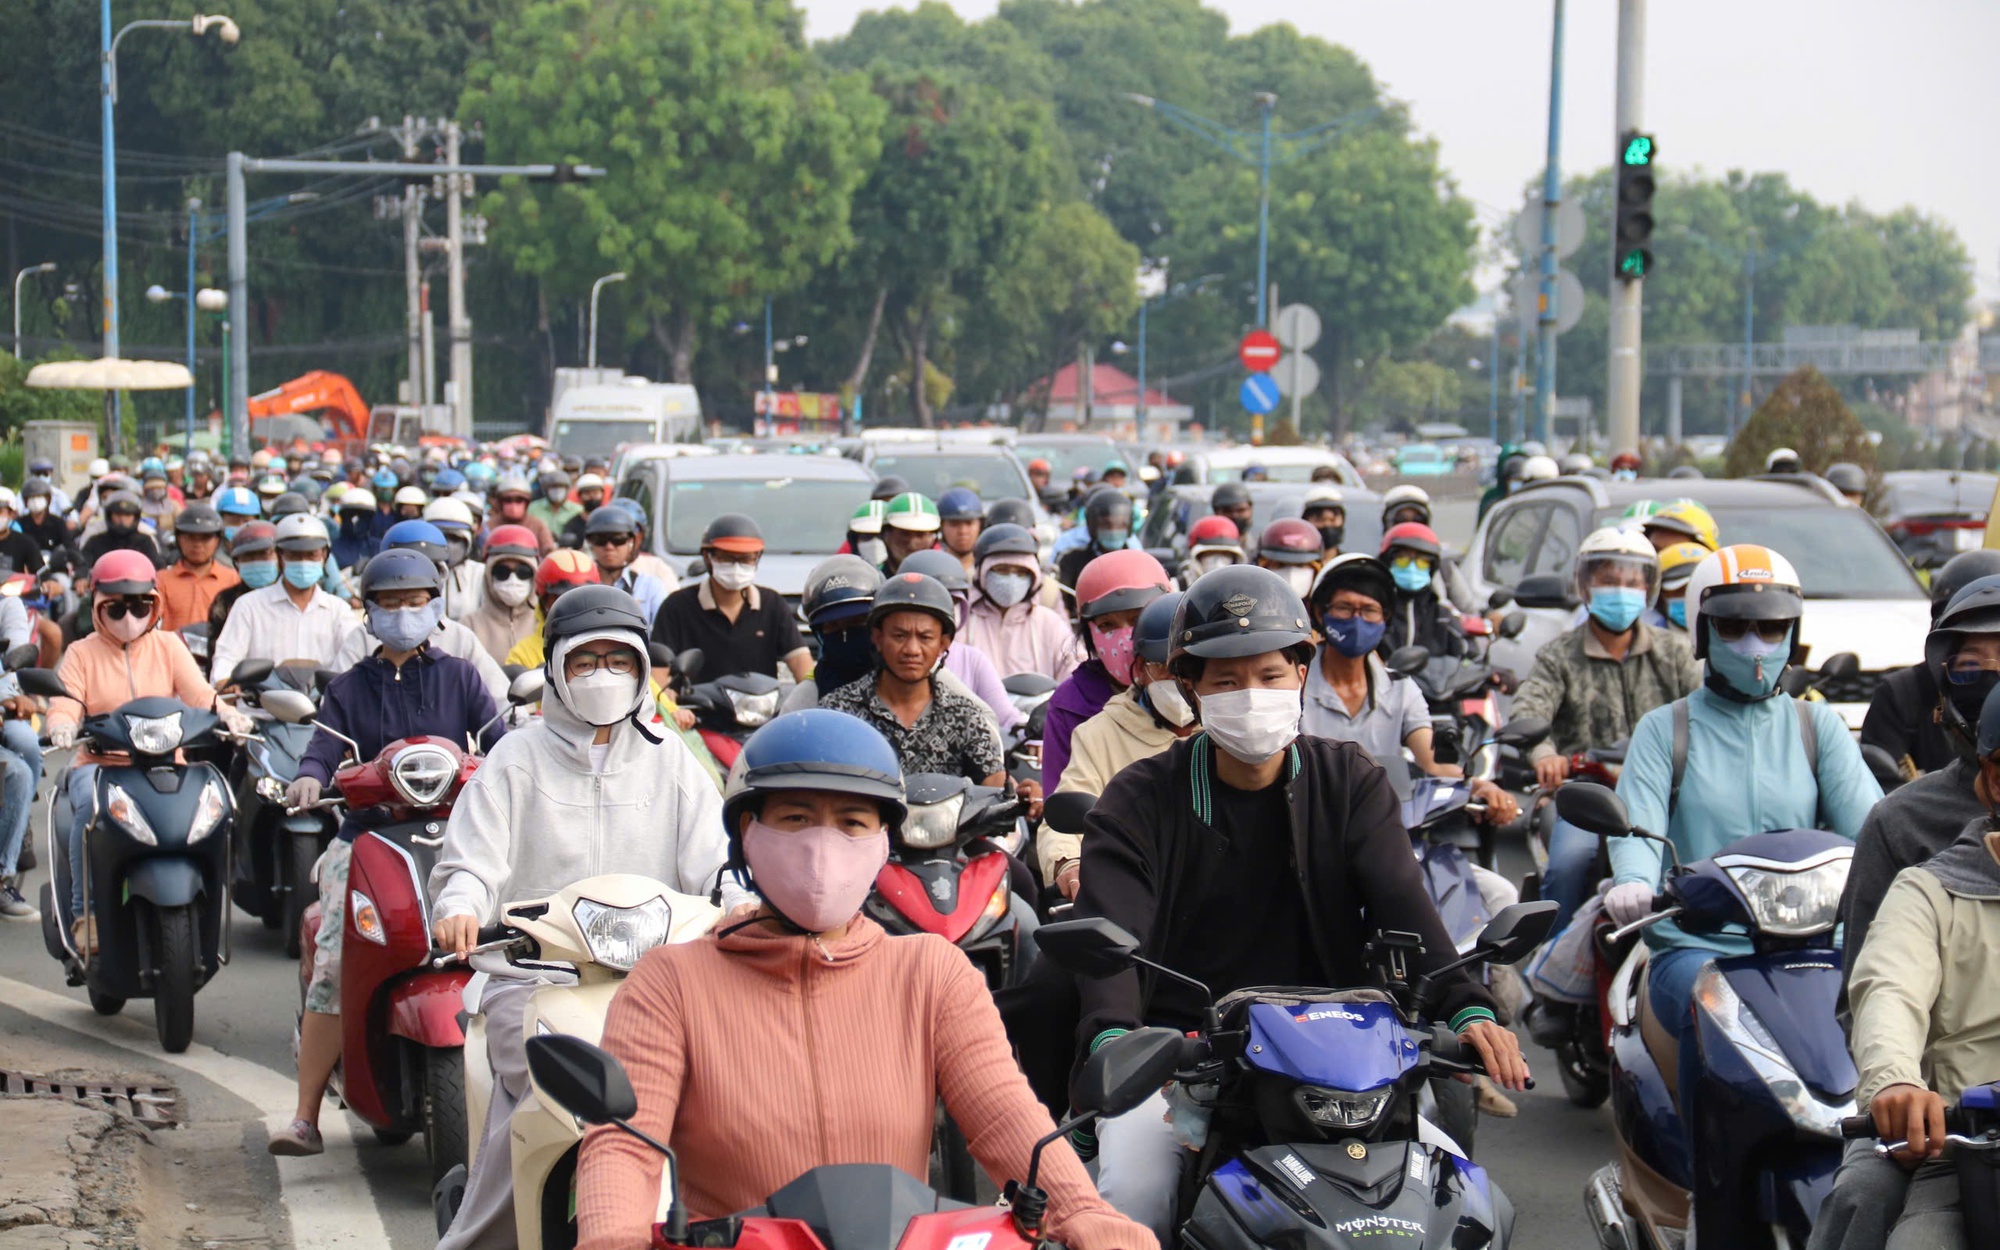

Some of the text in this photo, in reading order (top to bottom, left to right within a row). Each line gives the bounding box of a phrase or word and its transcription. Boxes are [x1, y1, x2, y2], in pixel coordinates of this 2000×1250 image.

[1308, 1010, 1365, 1022] ENEOS
[1281, 1153, 1316, 1185] YAMALUBE
[1335, 1215, 1426, 1234] MONSTER
[1352, 1229, 1415, 1238] ENERGY
